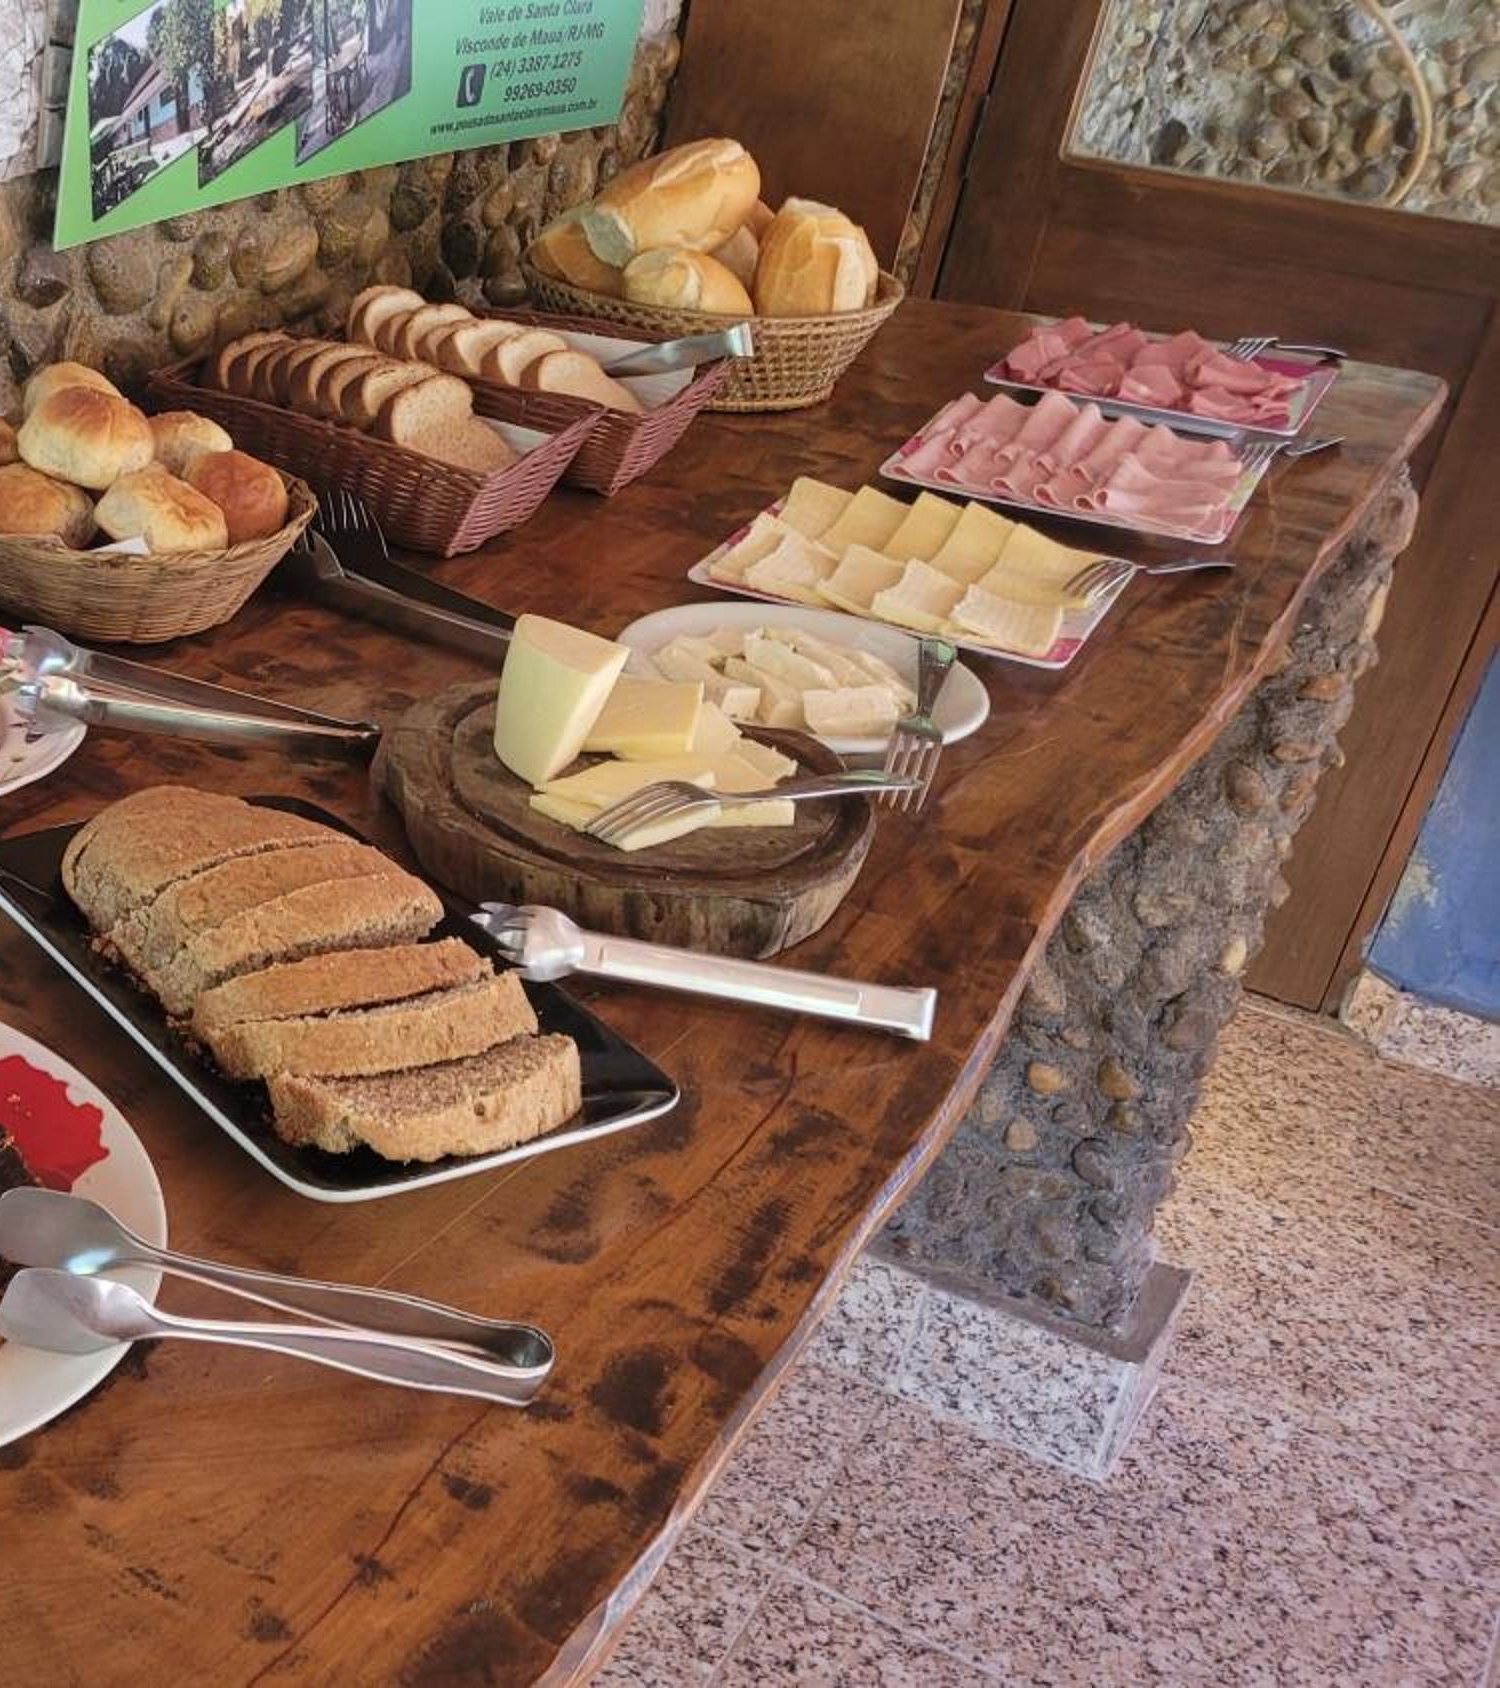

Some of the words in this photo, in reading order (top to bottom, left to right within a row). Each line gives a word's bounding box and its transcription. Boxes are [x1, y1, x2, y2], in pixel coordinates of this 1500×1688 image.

[479, 7, 506, 25] Vale
[507, 4, 524, 22] de
[525, 2, 560, 20] Santa
[563, 0, 594, 16] Clara
[455, 32, 510, 56] Visconde
[511, 31, 526, 50] de
[489, 59, 516, 81] (24)
[517, 51, 583, 75] 3387-1275
